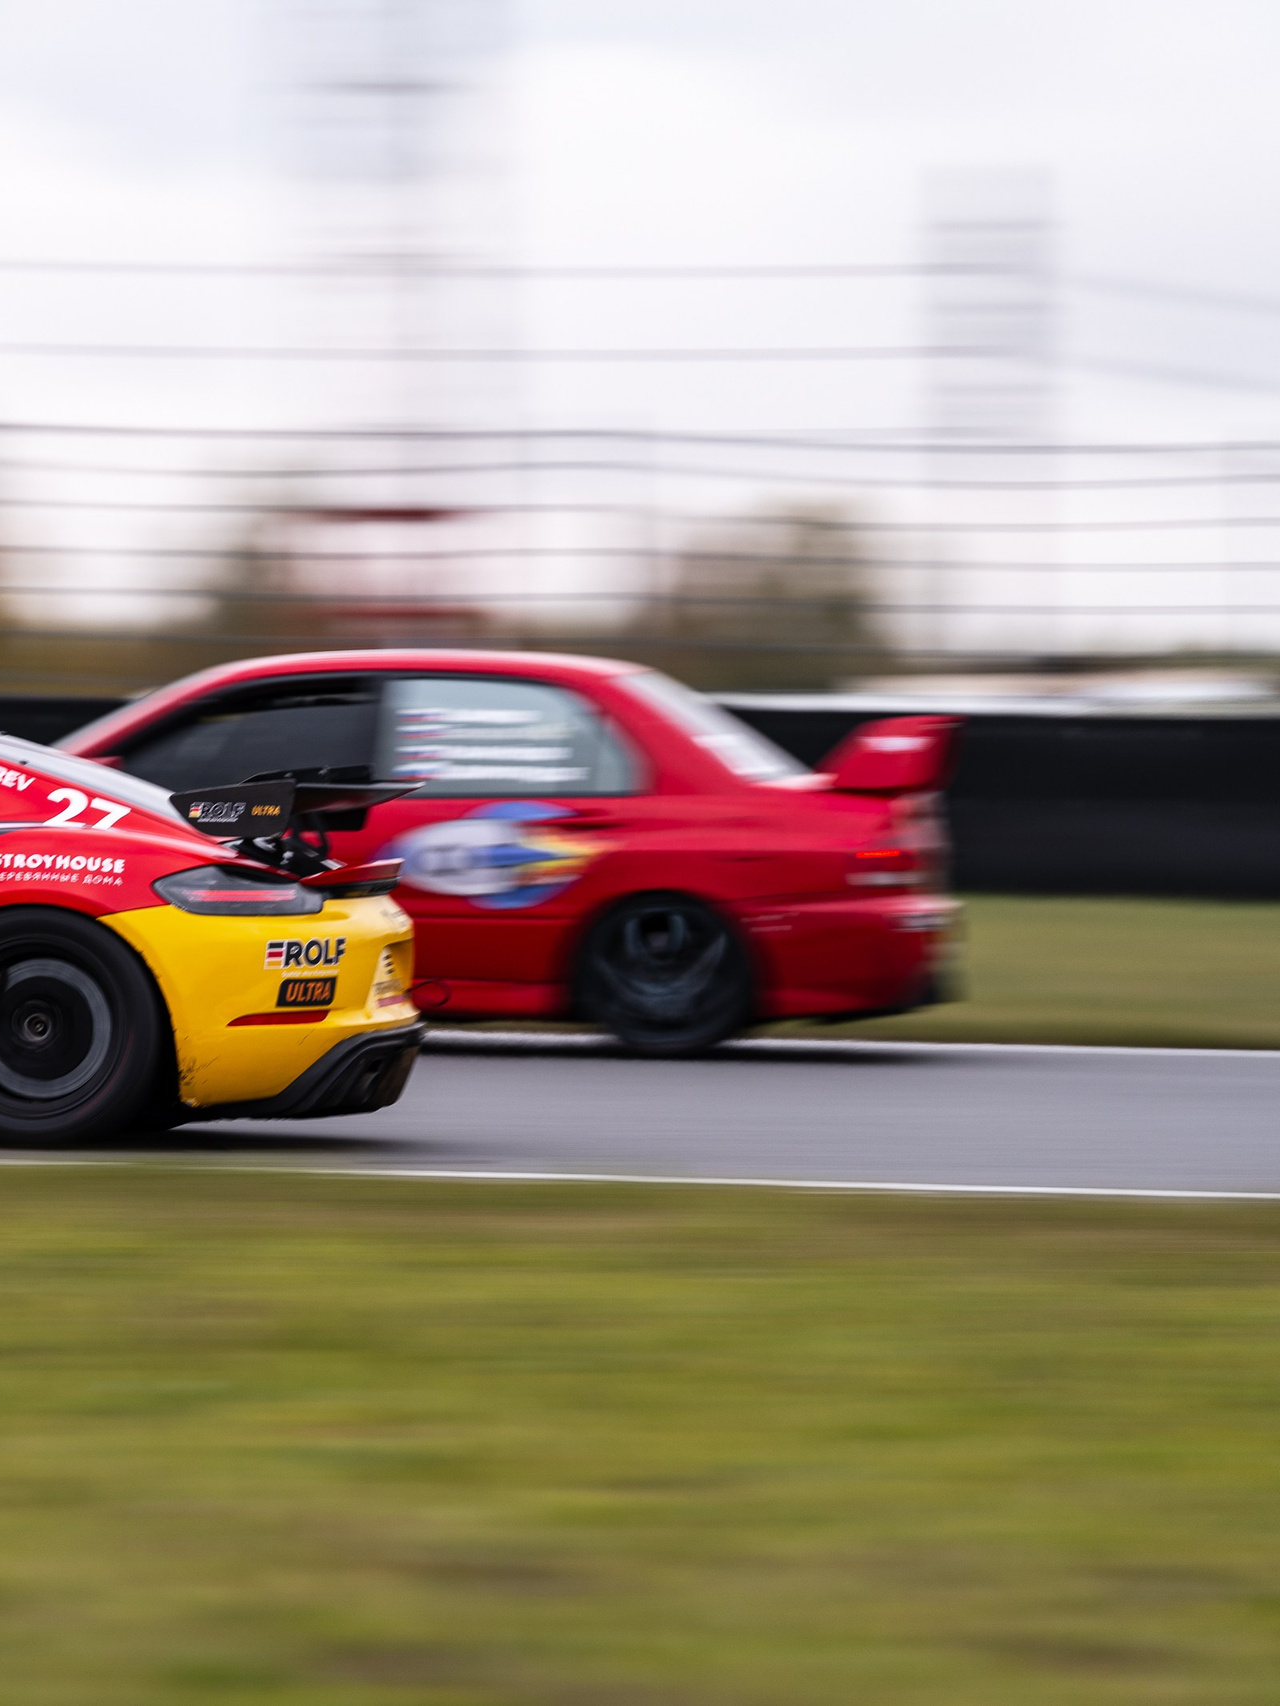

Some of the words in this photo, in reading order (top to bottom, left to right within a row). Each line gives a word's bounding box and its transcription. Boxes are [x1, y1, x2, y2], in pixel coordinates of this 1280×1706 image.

[42, 787, 132, 830] 27
[282, 937, 346, 969] ROLF
[285, 981, 332, 1002] ULTRA
